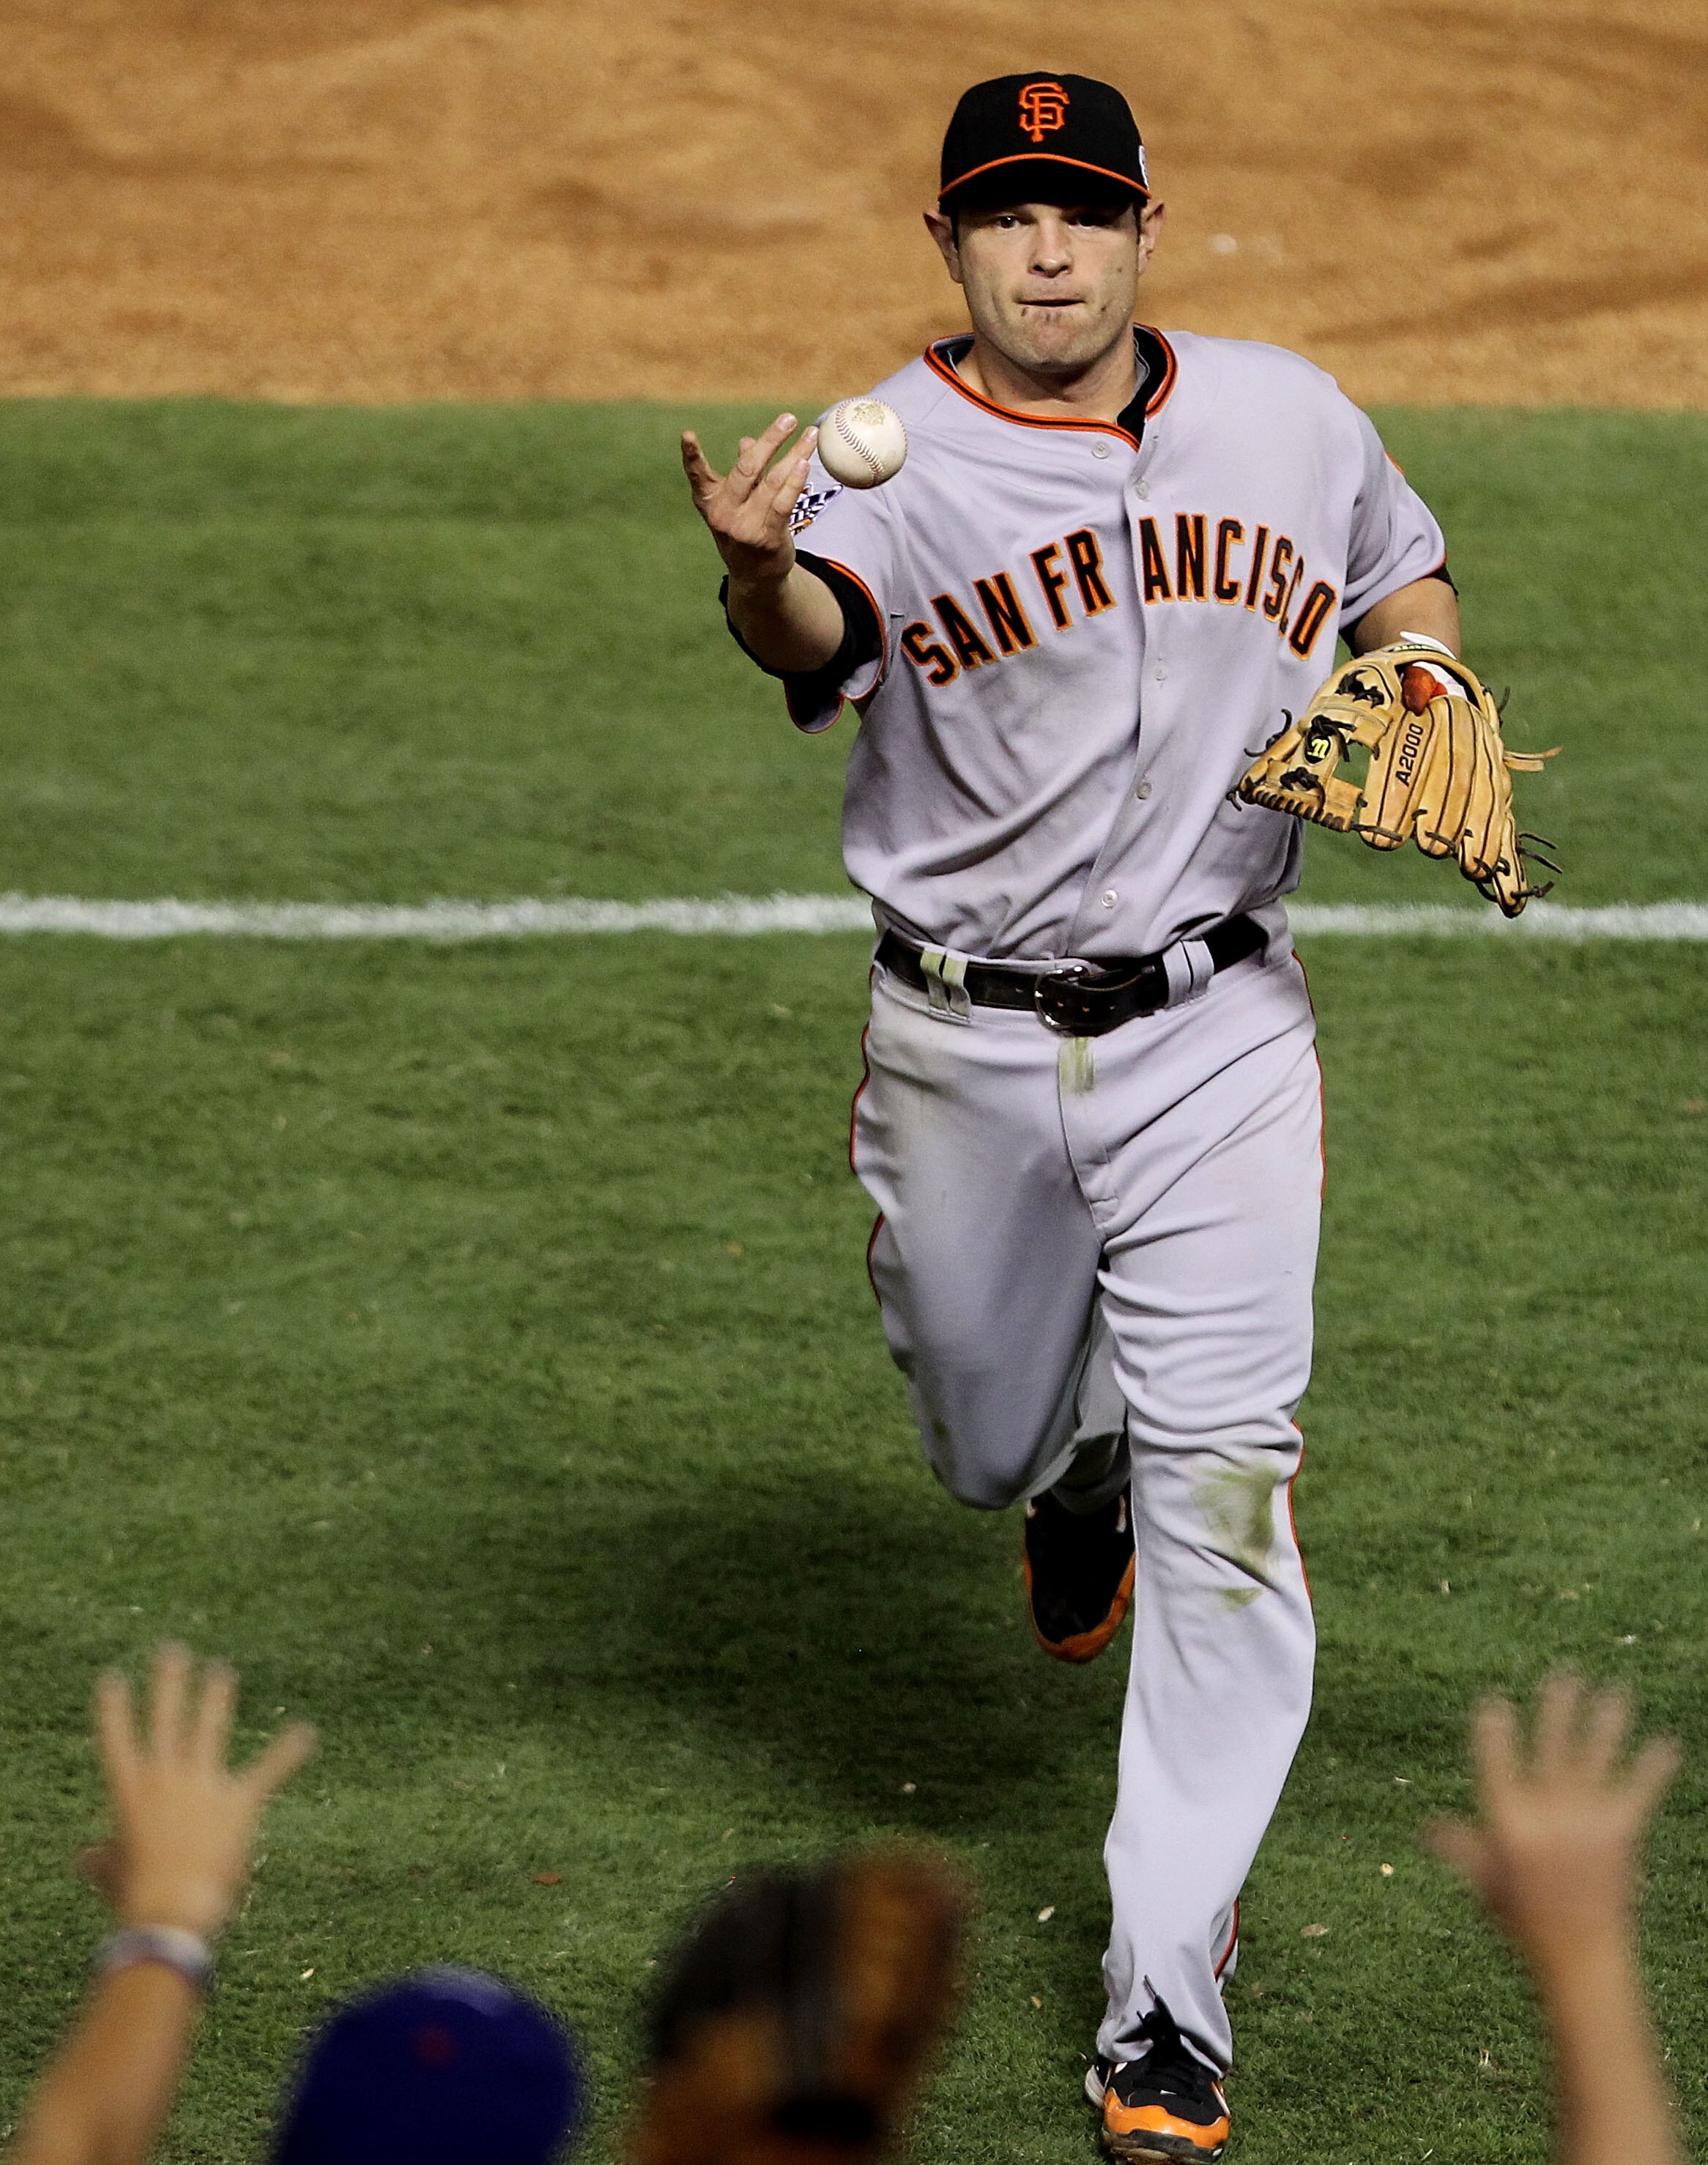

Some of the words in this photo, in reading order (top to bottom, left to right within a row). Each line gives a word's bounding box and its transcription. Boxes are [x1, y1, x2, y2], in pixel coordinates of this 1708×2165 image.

[1018, 82, 1070, 142] SF
[902, 571, 1038, 688] SAN
[1395, 723, 1424, 787] A2000
